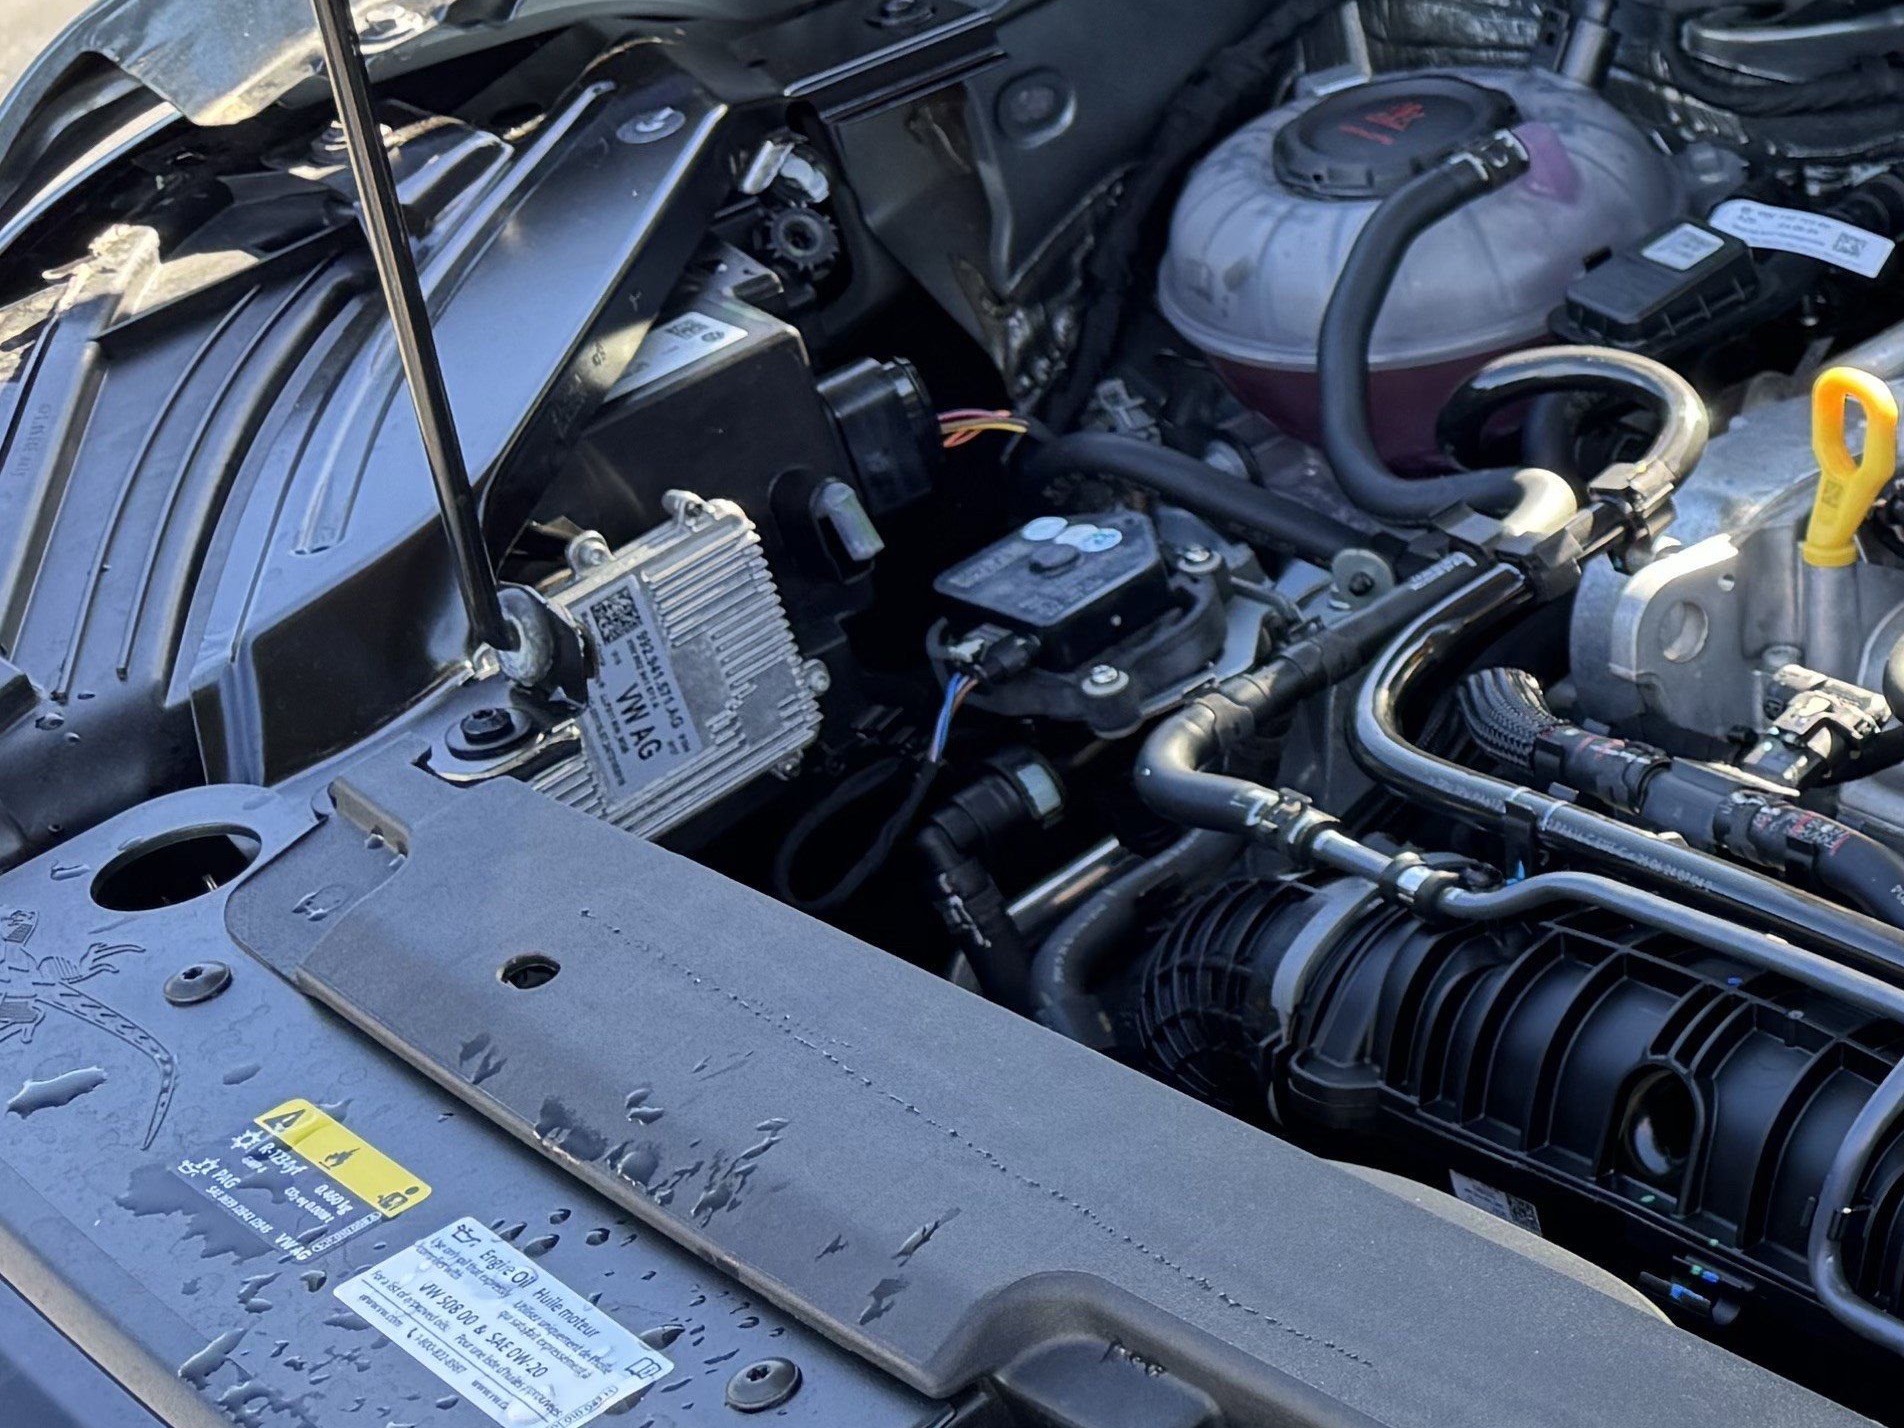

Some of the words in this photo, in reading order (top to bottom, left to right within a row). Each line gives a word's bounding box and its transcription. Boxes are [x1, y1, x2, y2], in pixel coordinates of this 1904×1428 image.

[616, 683, 650, 721] VW
[631, 724, 662, 762] AG
[209, 1167, 243, 1190] PAG
[507, 1269, 539, 1289] Oil
[529, 1286, 569, 1313] Huile
[556, 1306, 604, 1339] moteur
[415, 1280, 447, 1301] VW
[434, 1294, 466, 1315] 508
[453, 1308, 481, 1327] 00
[471, 1323, 490, 1335] &
[483, 1330, 515, 1353] SAE
[503, 1346, 550, 1379] 0W-20
